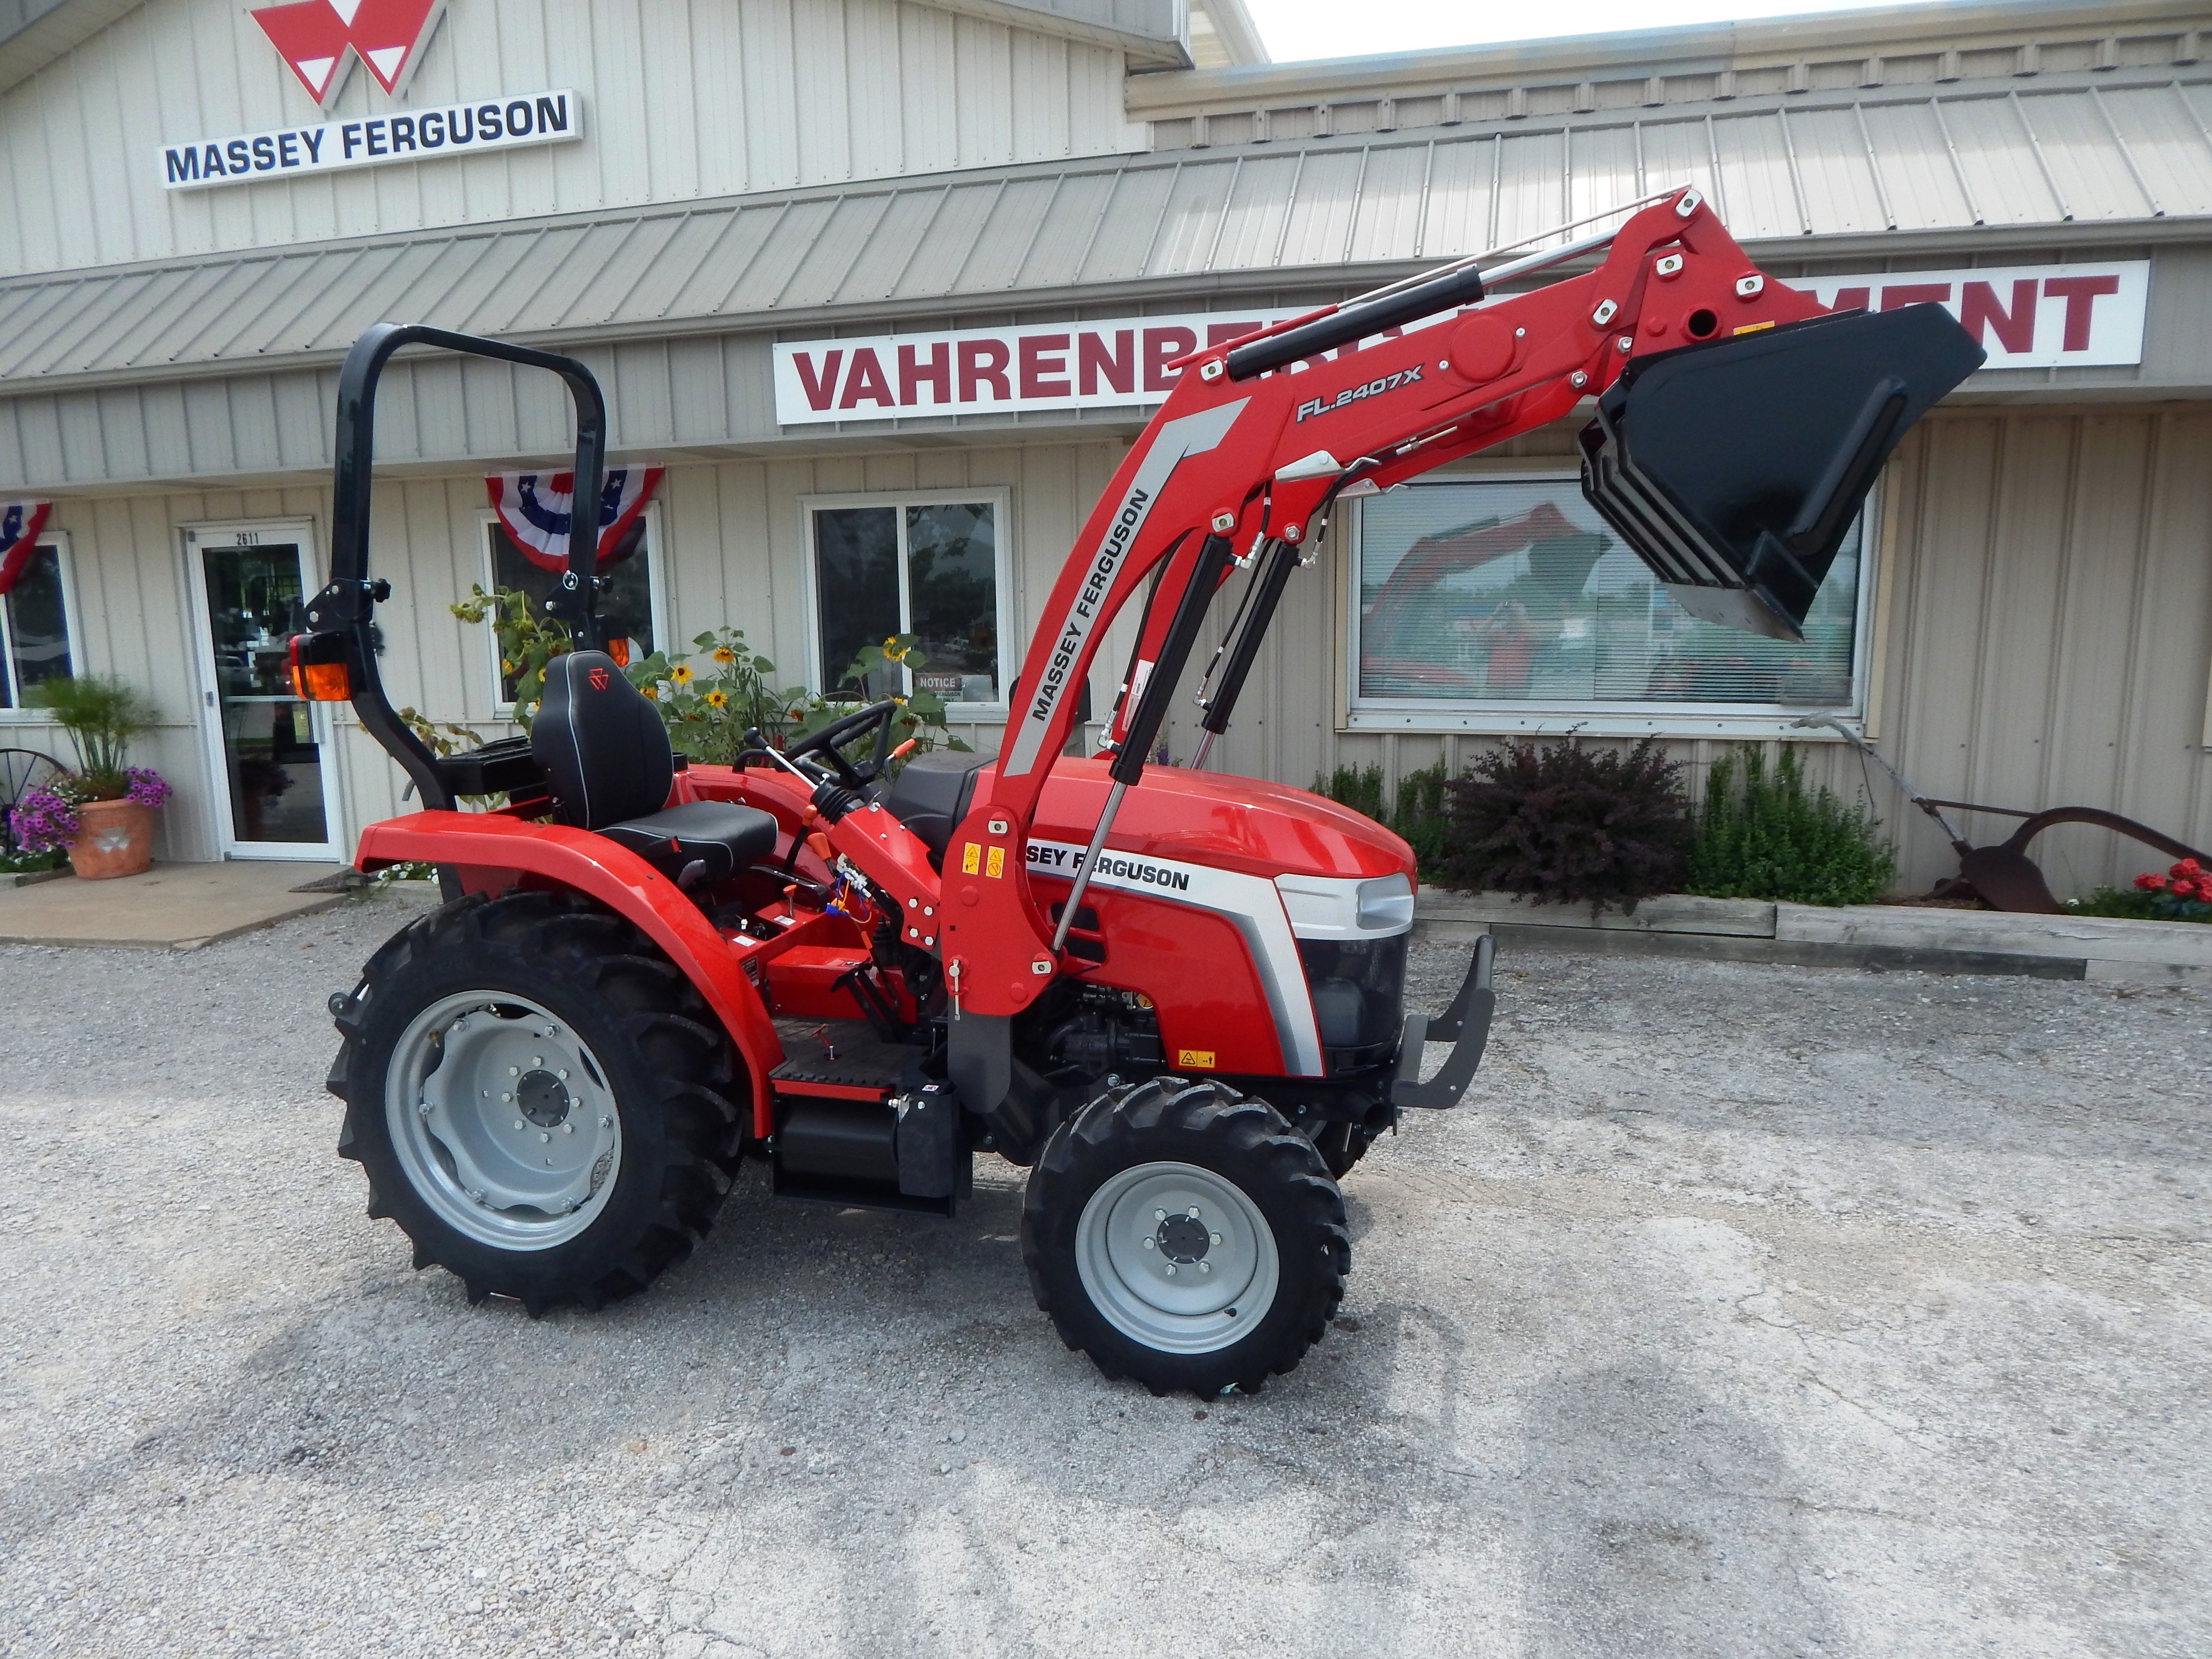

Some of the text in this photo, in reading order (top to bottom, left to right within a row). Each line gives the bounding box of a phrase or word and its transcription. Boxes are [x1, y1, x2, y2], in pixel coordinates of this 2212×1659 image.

[165, 95, 567, 183] MASSEY FERGUSON
[1296, 363, 1425, 423] FL.2407X
[236, 532, 258, 545] 2611
[1032, 488, 1149, 721] MASSEY FERGUSON
[920, 677, 955, 687] NOTICE
[1072, 852, 1190, 891] FRGUSON
